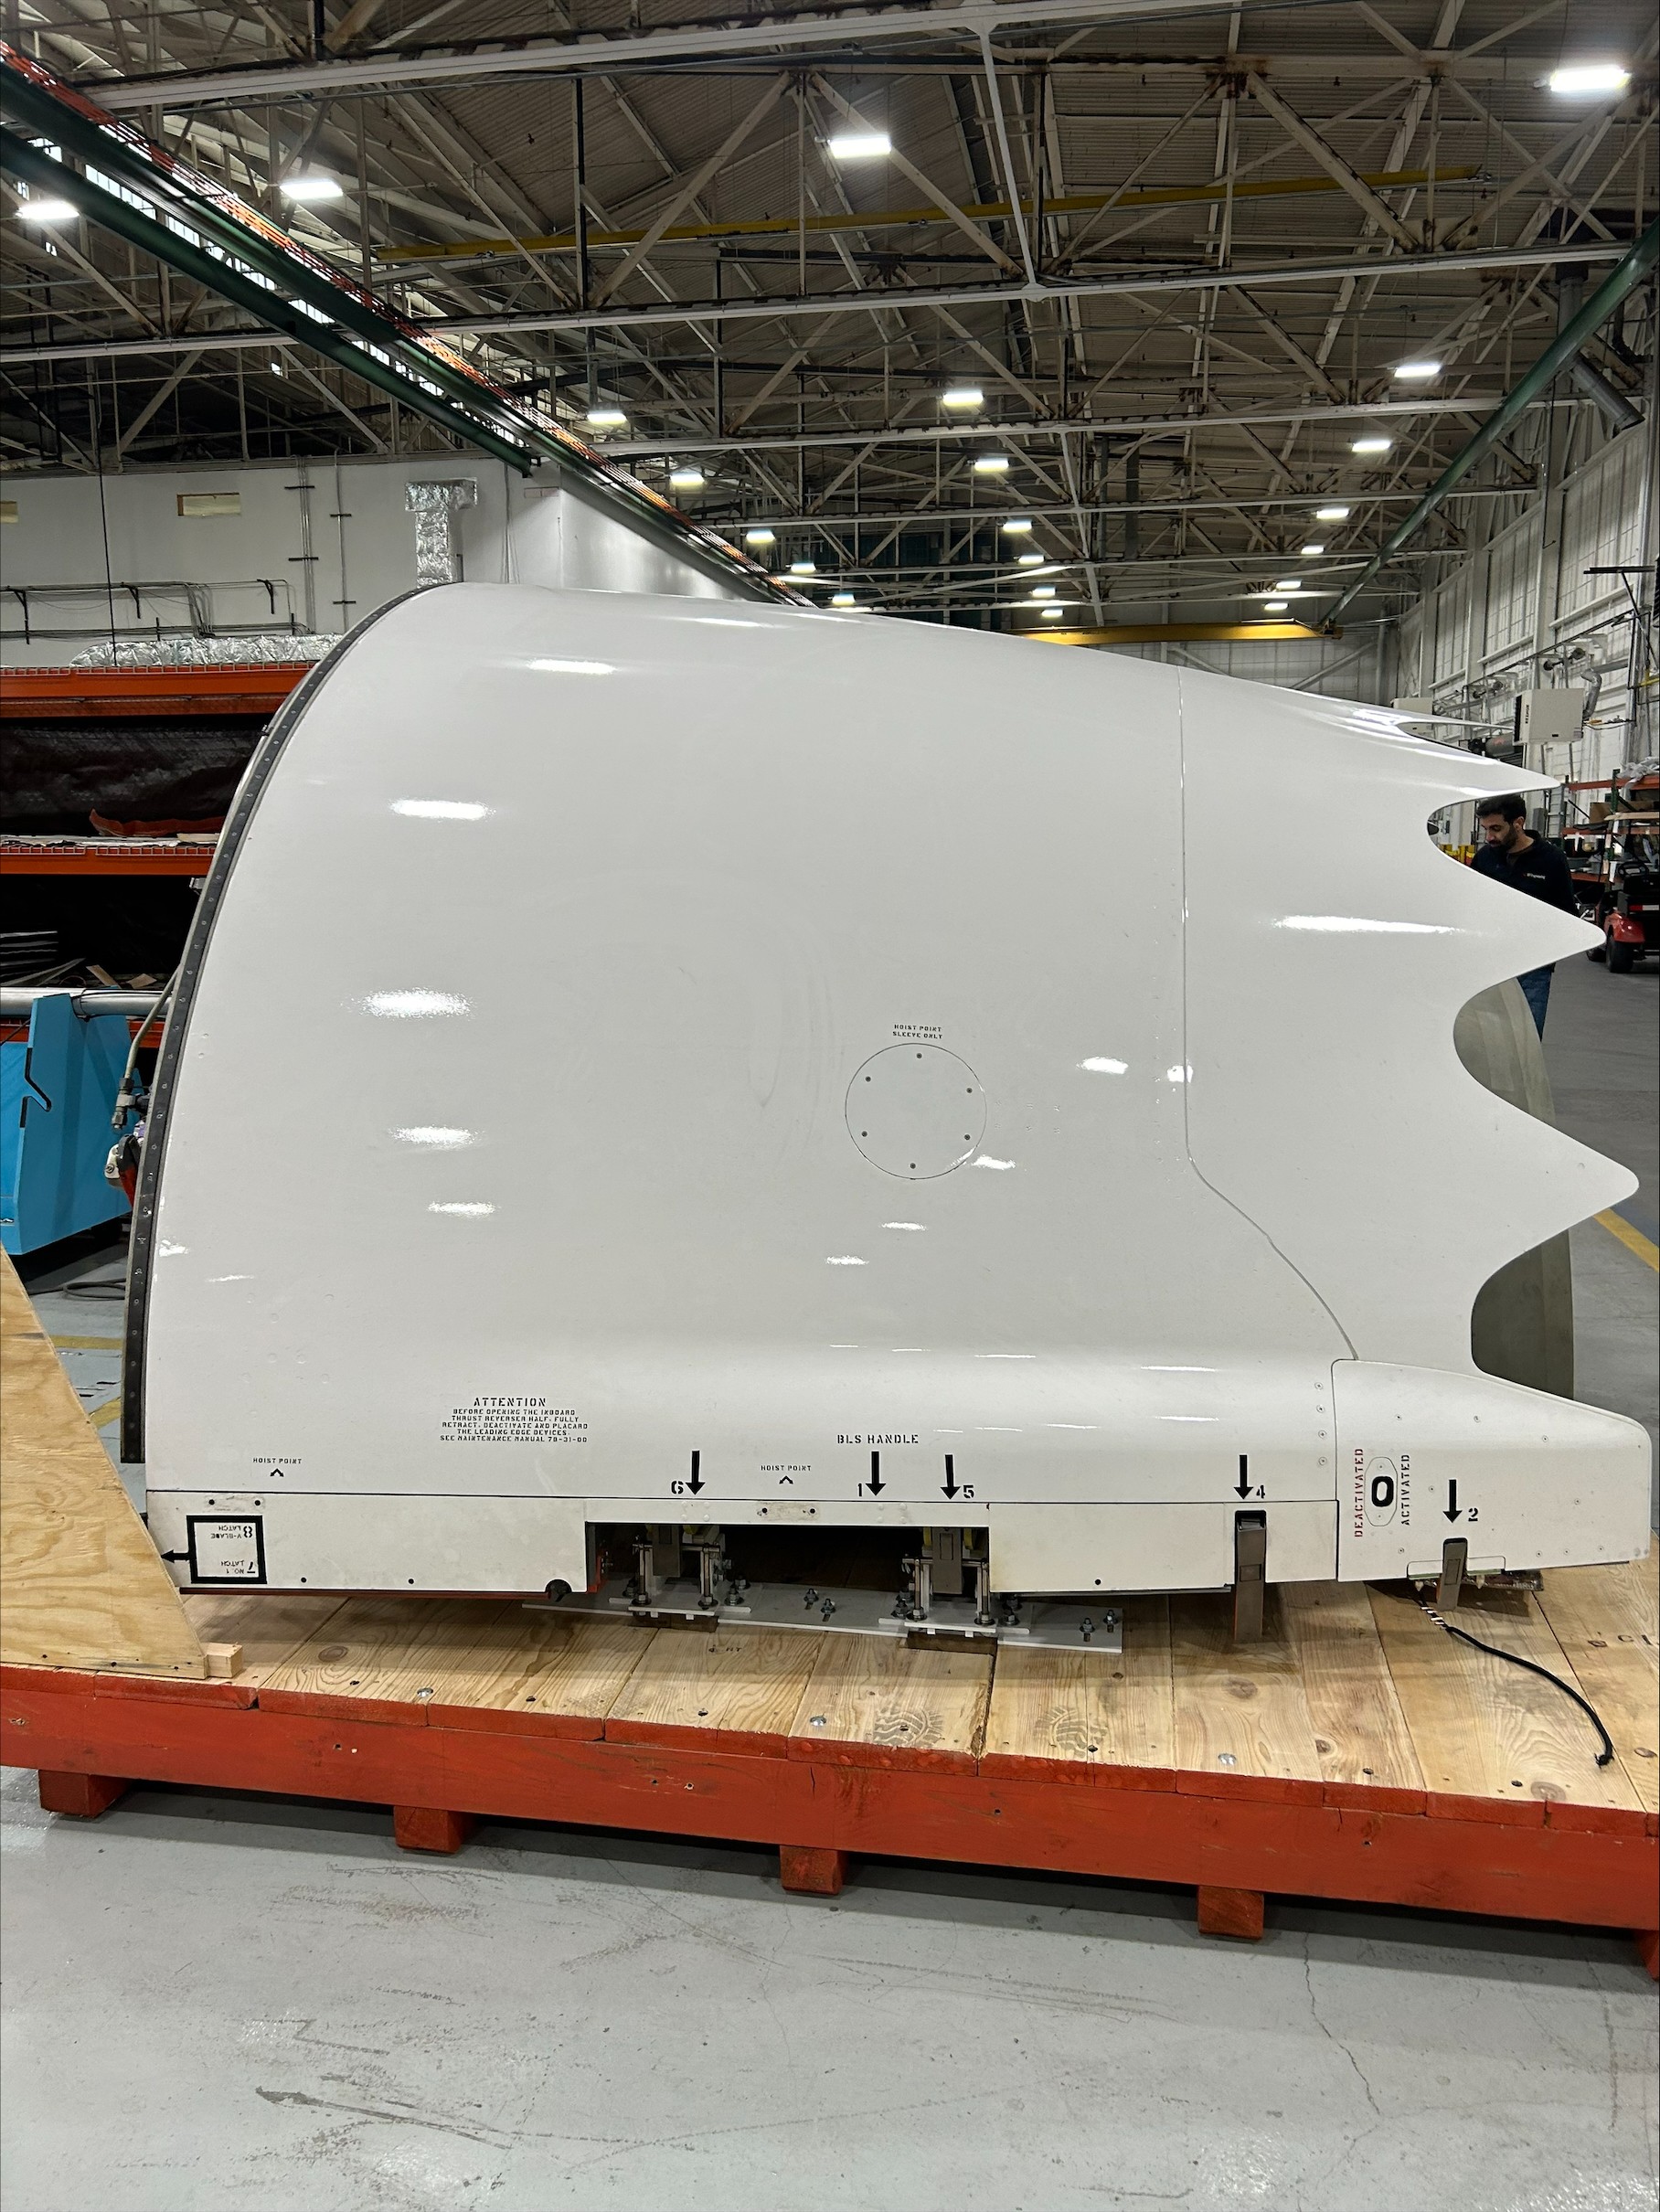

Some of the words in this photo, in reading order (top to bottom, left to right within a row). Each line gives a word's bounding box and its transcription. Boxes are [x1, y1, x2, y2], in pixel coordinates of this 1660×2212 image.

[474, 1397, 547, 1407] ATTENTION
[837, 1434, 862, 1444] BLS
[867, 1434, 919, 1444] HANDLE
[671, 1480, 684, 1494] 6
[857, 1483, 863, 1497] 1
[963, 1484, 974, 1499] 5
[1256, 1484, 1266, 1499] 4
[1354, 1449, 1363, 1537] DEACTIVATED
[1400, 1454, 1410, 1526] ACTIVATED
[1467, 1507, 1479, 1522] 2
